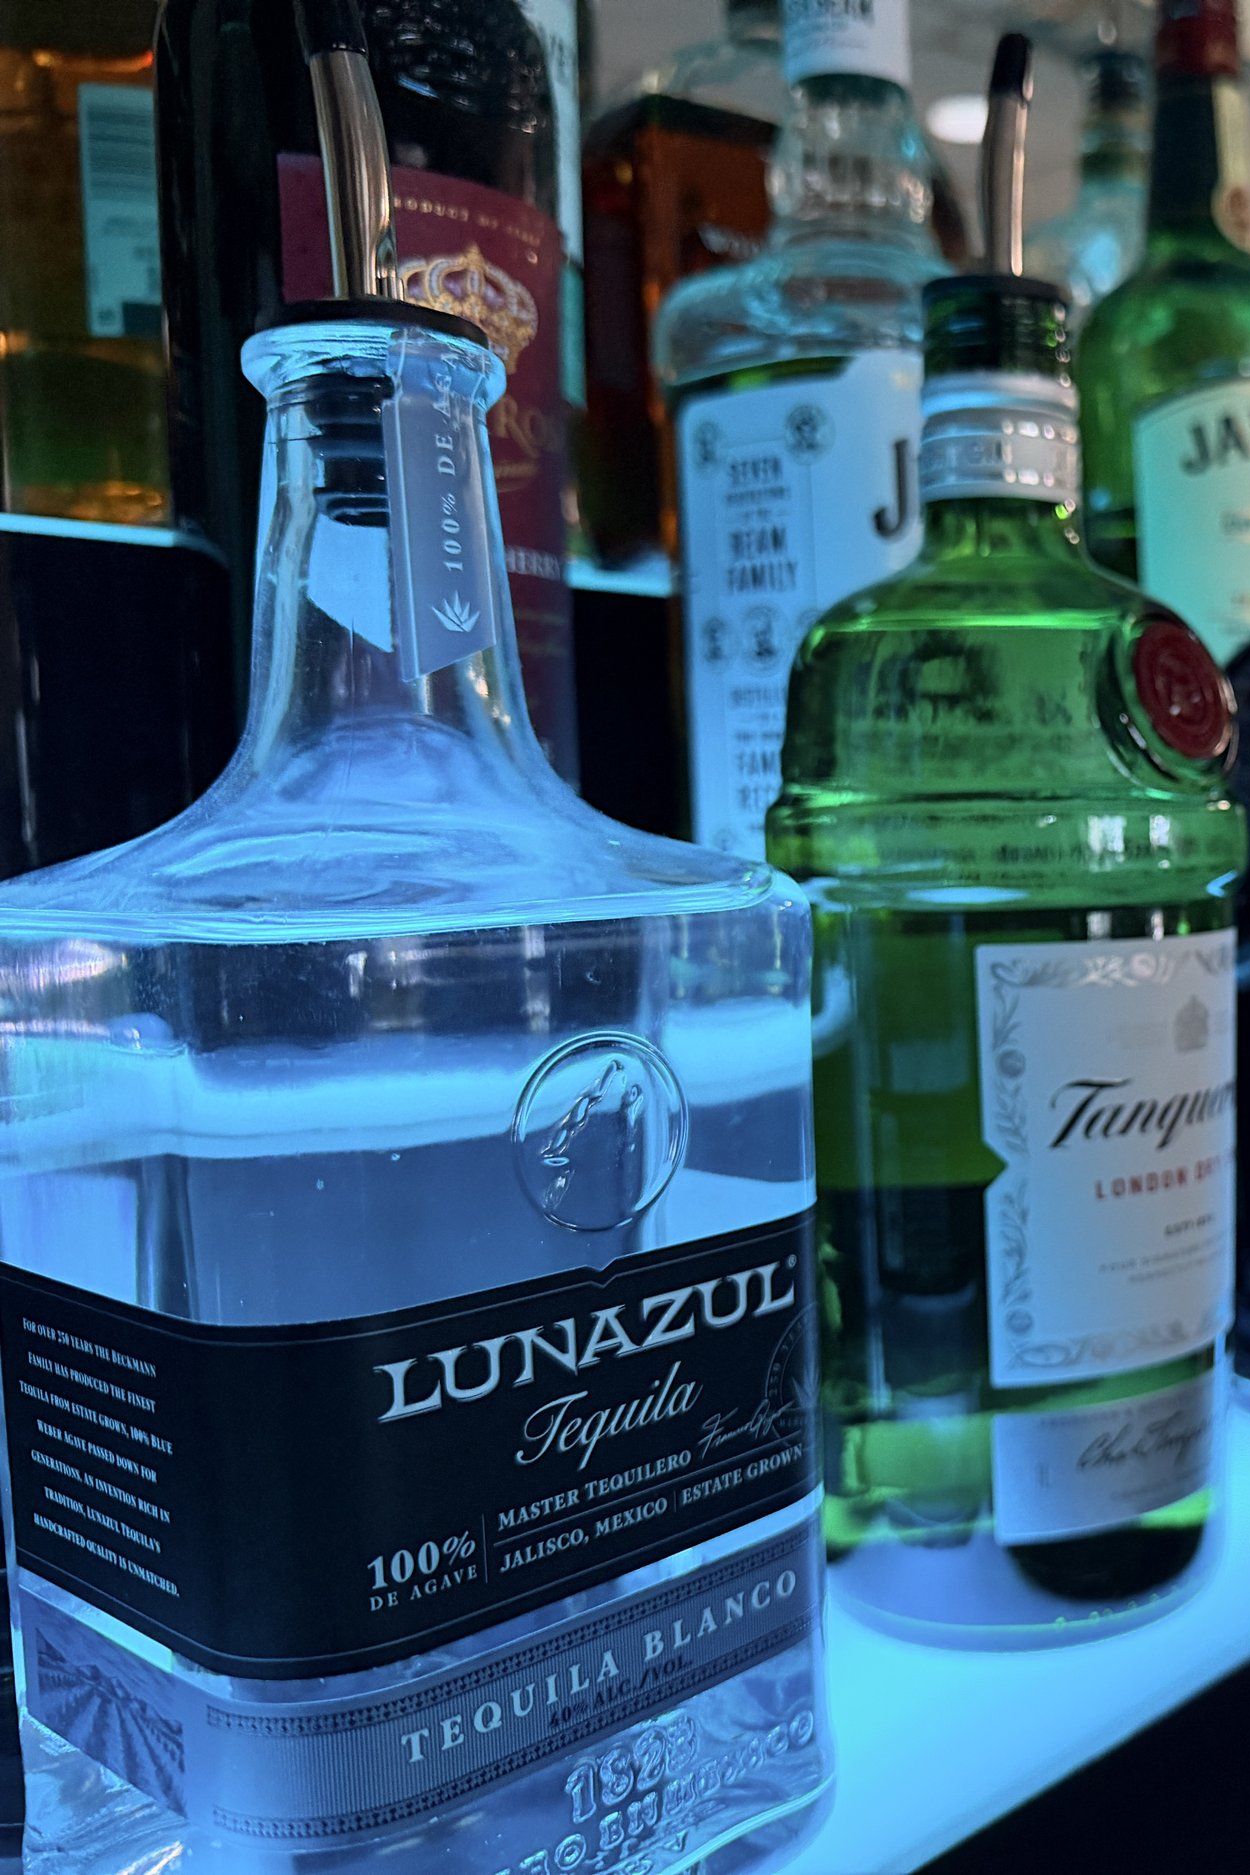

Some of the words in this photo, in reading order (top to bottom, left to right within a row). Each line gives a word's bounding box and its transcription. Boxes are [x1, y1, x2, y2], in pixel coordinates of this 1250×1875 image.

[435, 435, 455, 476] DE
[442, 493, 463, 572] 100%
[1048, 1077, 1235, 1151] Tanqu
[1095, 1165, 1188, 1200] LONDON
[22, 1317, 36, 1333] FOR
[38, 1324, 56, 1340] OVER
[57, 1330, 69, 1345] 250
[70, 1335, 93, 1354] YEARS
[95, 1344, 110, 1361] THE
[112, 1349, 156, 1378] BECKMANN
[28, 1351, 52, 1373] FAMILY
[54, 1362, 69, 1379] HAS
[70, 1368, 109, 1394] PRODUCED
[110, 1383, 126, 1401] THE
[127, 1391, 156, 1414] FINEST
[19, 1379, 50, 1404] TEQUILA
[50, 1393, 70, 1412] FROM
[71, 1402, 98, 1423] ESTATE
[130, 1426, 150, 1446] 100%
[151, 1433, 173, 1455] BLUE
[515, 1361, 703, 1471] Tequila
[37, 1419, 62, 1441] WEBER
[64, 1431, 87, 1451] AGAVE
[88, 1442, 115, 1464] PASSED
[116, 1455, 139, 1475] DOWN
[141, 1465, 157, 1484] FOR
[682, 1469, 743, 1506] ESTATE
[747, 1443, 803, 1480] GROWN
[87, 1505, 119, 1532] LUNAZUL
[95, 1478, 137, 1507] INVENTION
[138, 1497, 158, 1519] RICH
[160, 1508, 170, 1523] IN
[498, 1488, 580, 1531] MASTER
[585, 1450, 692, 1501] TEQUILERO
[33, 1512, 86, 1549] HANDCRAFTED
[86, 1539, 117, 1566] QUALITY
[118, 1556, 127, 1571] IS
[128, 1561, 180, 1597] UNMATCHED.
[367, 1530, 476, 1591] 100%
[500, 1527, 589, 1573] JALISCO,
[595, 1497, 668, 1538] MEXICO
[370, 1591, 399, 1612] DE
[410, 1565, 478, 1601] AGAVE
[401, 1649, 620, 1764] TEQUILA
[643, 1569, 797, 1662] BLANCO
